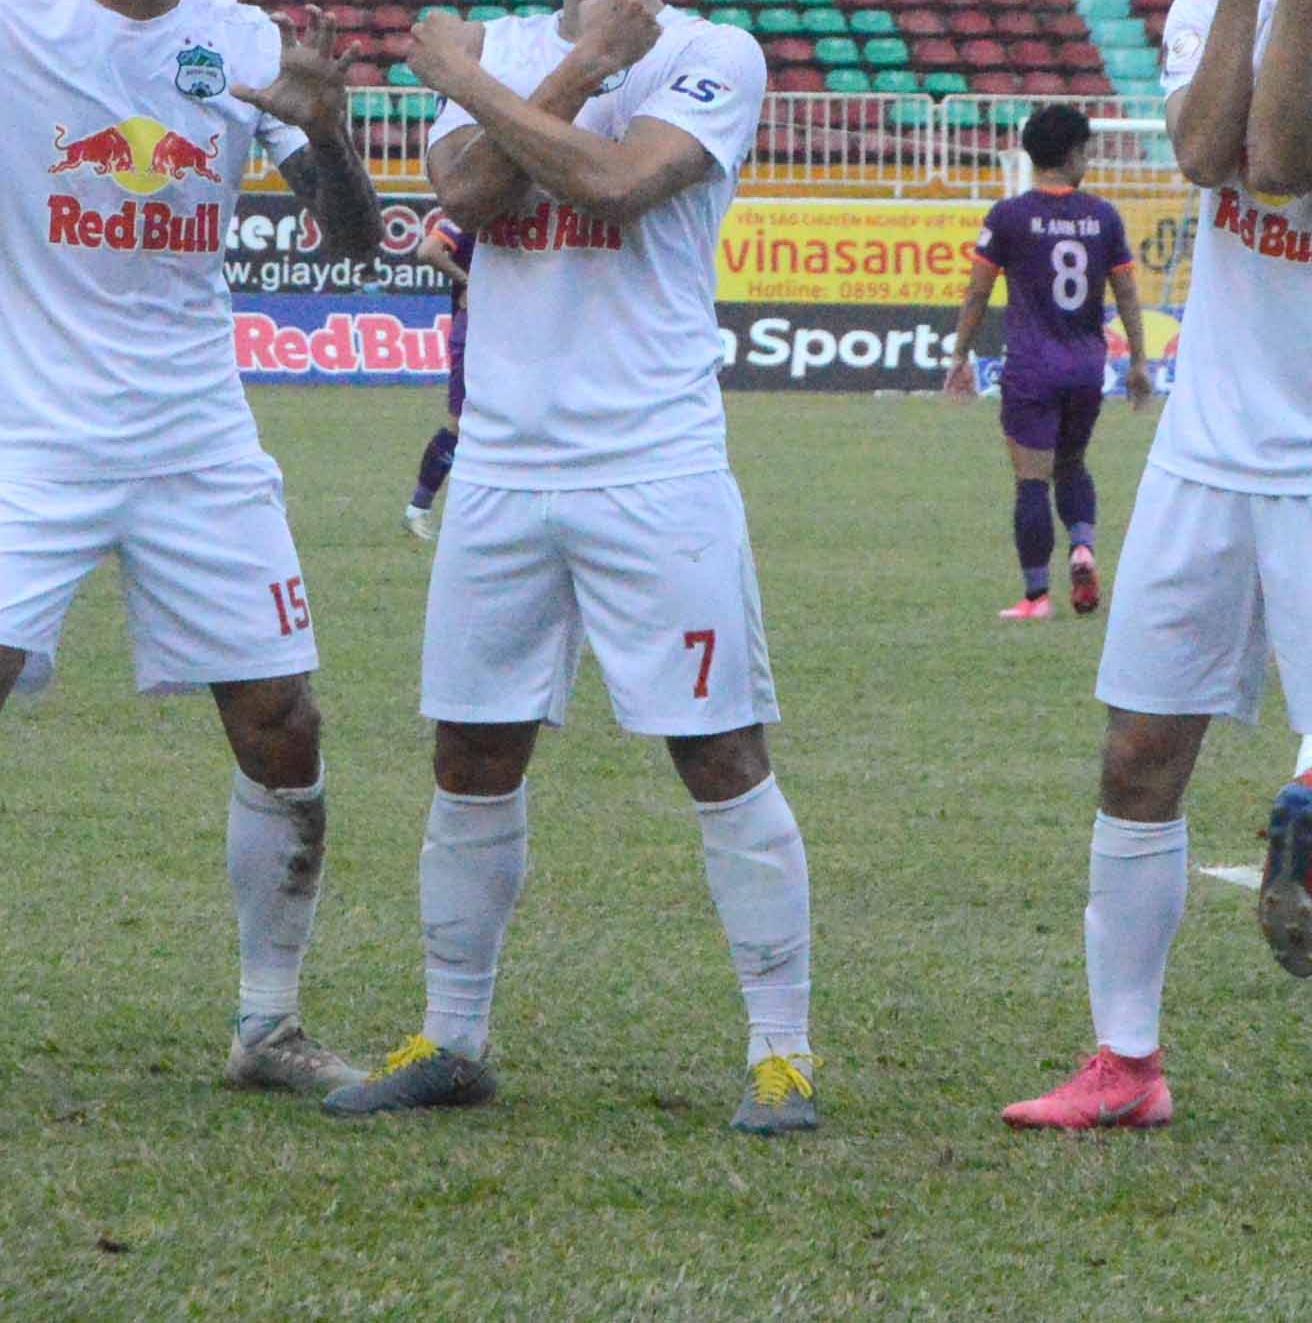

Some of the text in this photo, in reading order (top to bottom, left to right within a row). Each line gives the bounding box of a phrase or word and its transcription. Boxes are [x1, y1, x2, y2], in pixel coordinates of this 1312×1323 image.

[670, 74, 721, 103] LS
[47, 194, 221, 253] Red Bull
[1051, 239, 1088, 312] 8
[233, 312, 357, 372] Red
[268, 575, 310, 637] 15
[683, 628, 716, 700] 7
